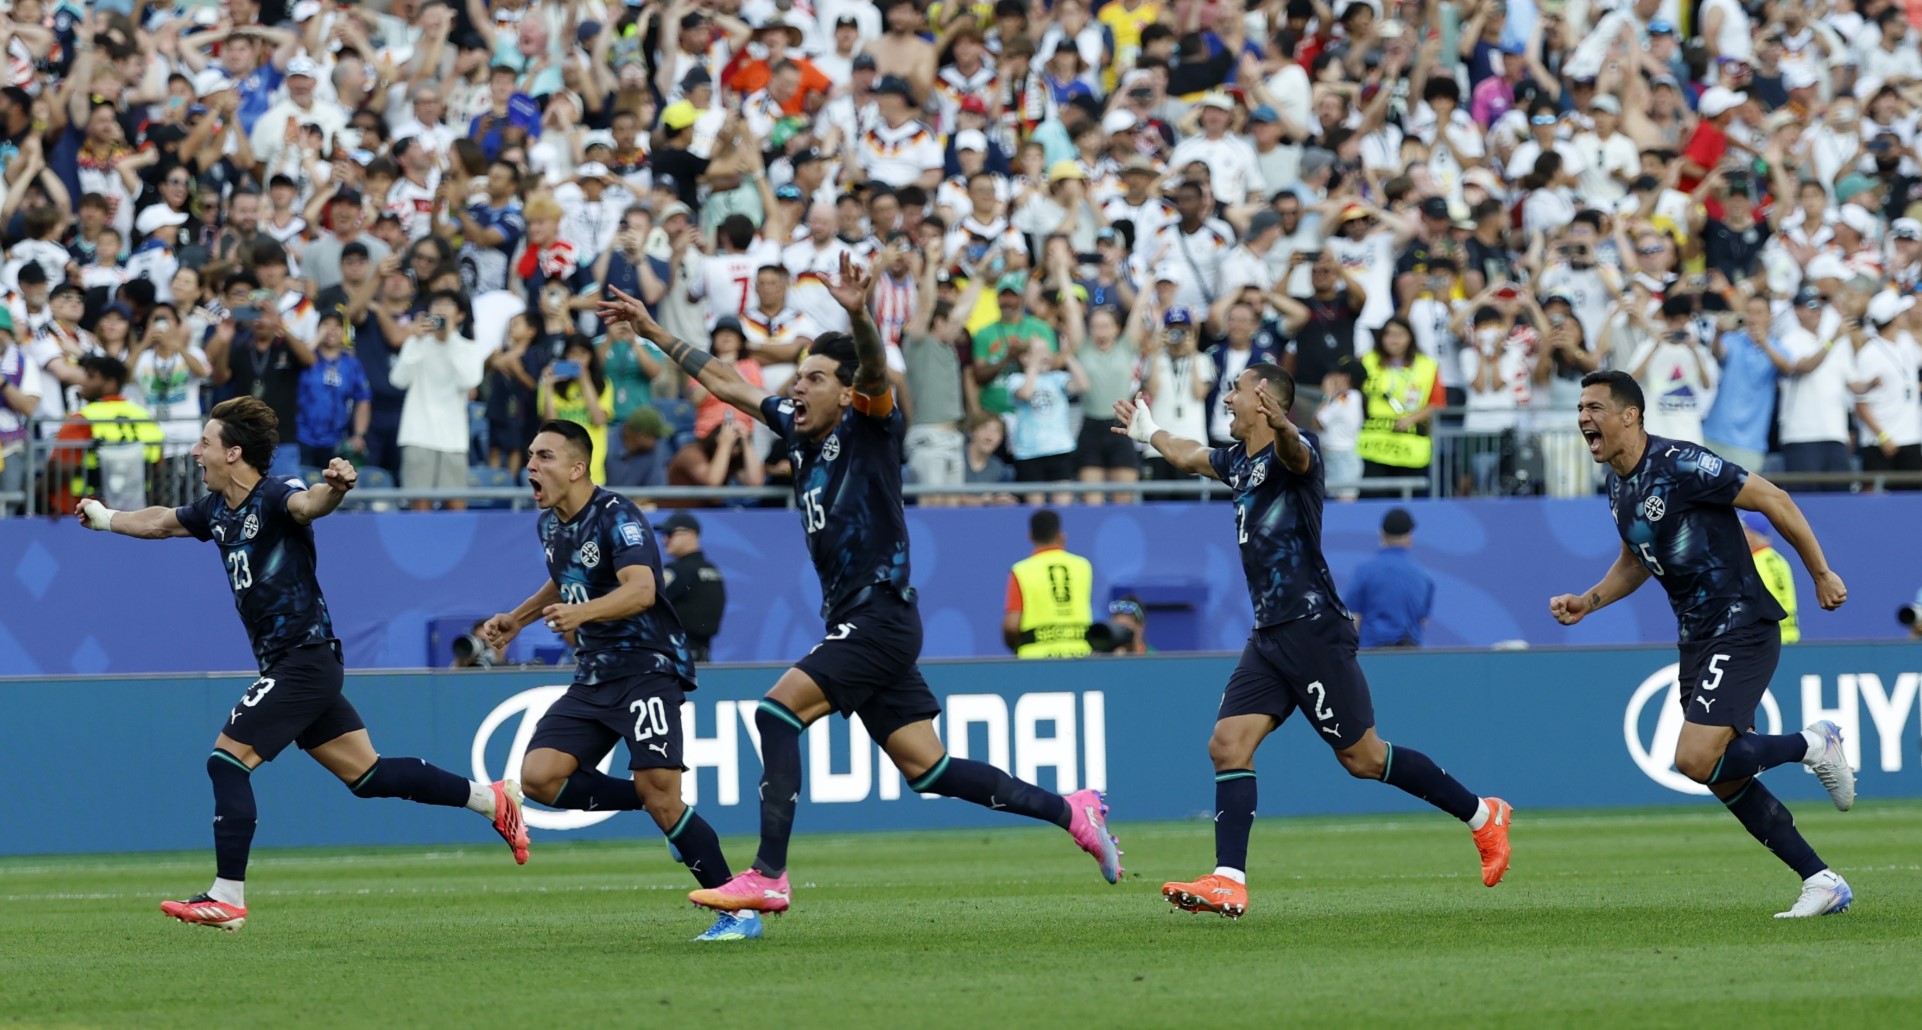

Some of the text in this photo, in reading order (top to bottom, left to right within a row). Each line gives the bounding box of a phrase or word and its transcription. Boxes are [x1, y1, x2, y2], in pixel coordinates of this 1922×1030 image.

[734, 277, 748, 315] 7
[804, 487, 825, 533] 15
[1238, 504, 1248, 544] 2
[229, 550, 252, 590] 23
[1639, 542, 1664, 576] 5
[240, 676, 276, 707] 3
[1702, 654, 1731, 690] 5
[630, 696, 669, 742] 20
[1307, 680, 1334, 721] 2
[1801, 672, 1922, 772] HY
